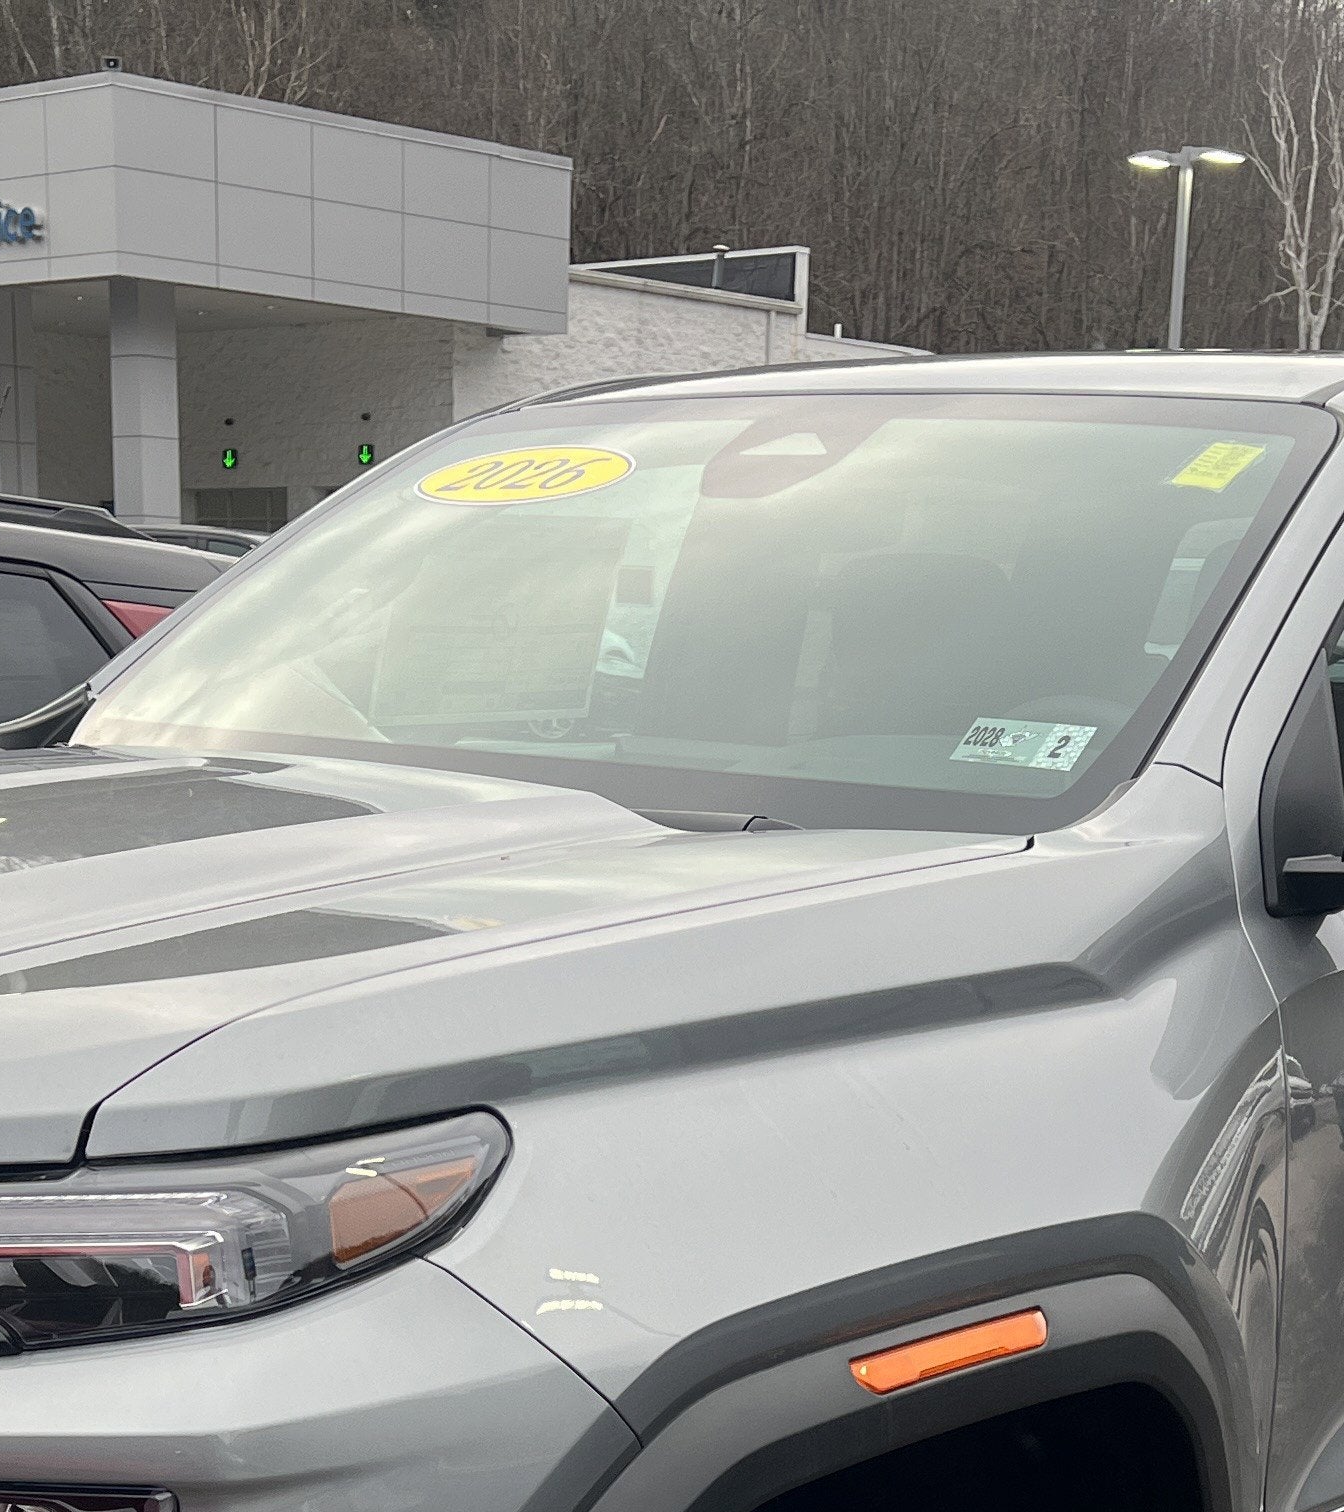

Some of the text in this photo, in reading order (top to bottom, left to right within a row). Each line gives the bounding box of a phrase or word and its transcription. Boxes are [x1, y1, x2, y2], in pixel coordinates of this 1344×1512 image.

[434, 457, 613, 492] 2026
[963, 725, 1006, 748] 2028
[1047, 734, 1072, 759] 2
